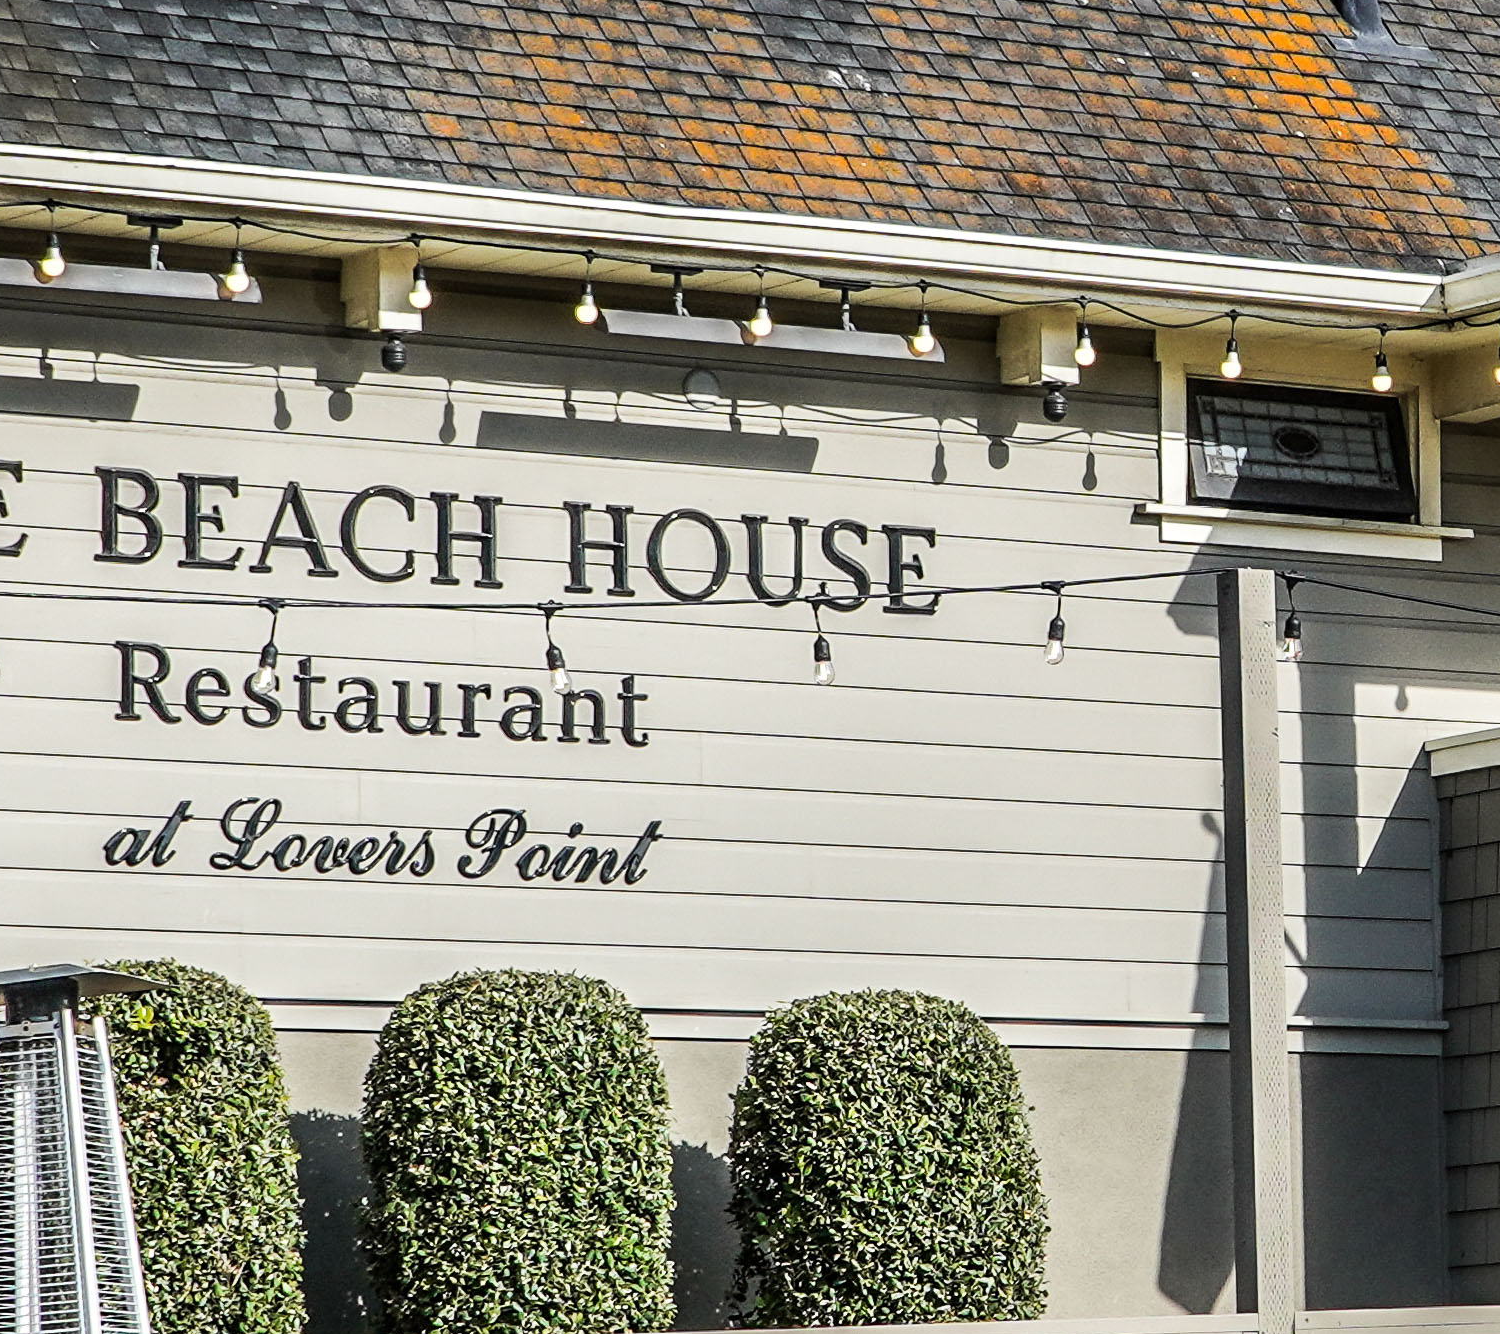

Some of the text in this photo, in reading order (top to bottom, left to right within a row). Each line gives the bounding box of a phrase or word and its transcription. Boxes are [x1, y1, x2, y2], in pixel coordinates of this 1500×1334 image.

[94, 466, 504, 589] BEACH
[563, 501, 942, 615] HOUSE
[113, 640, 650, 747] Restaurant
[102, 796, 664, 886] at Lovers Point
